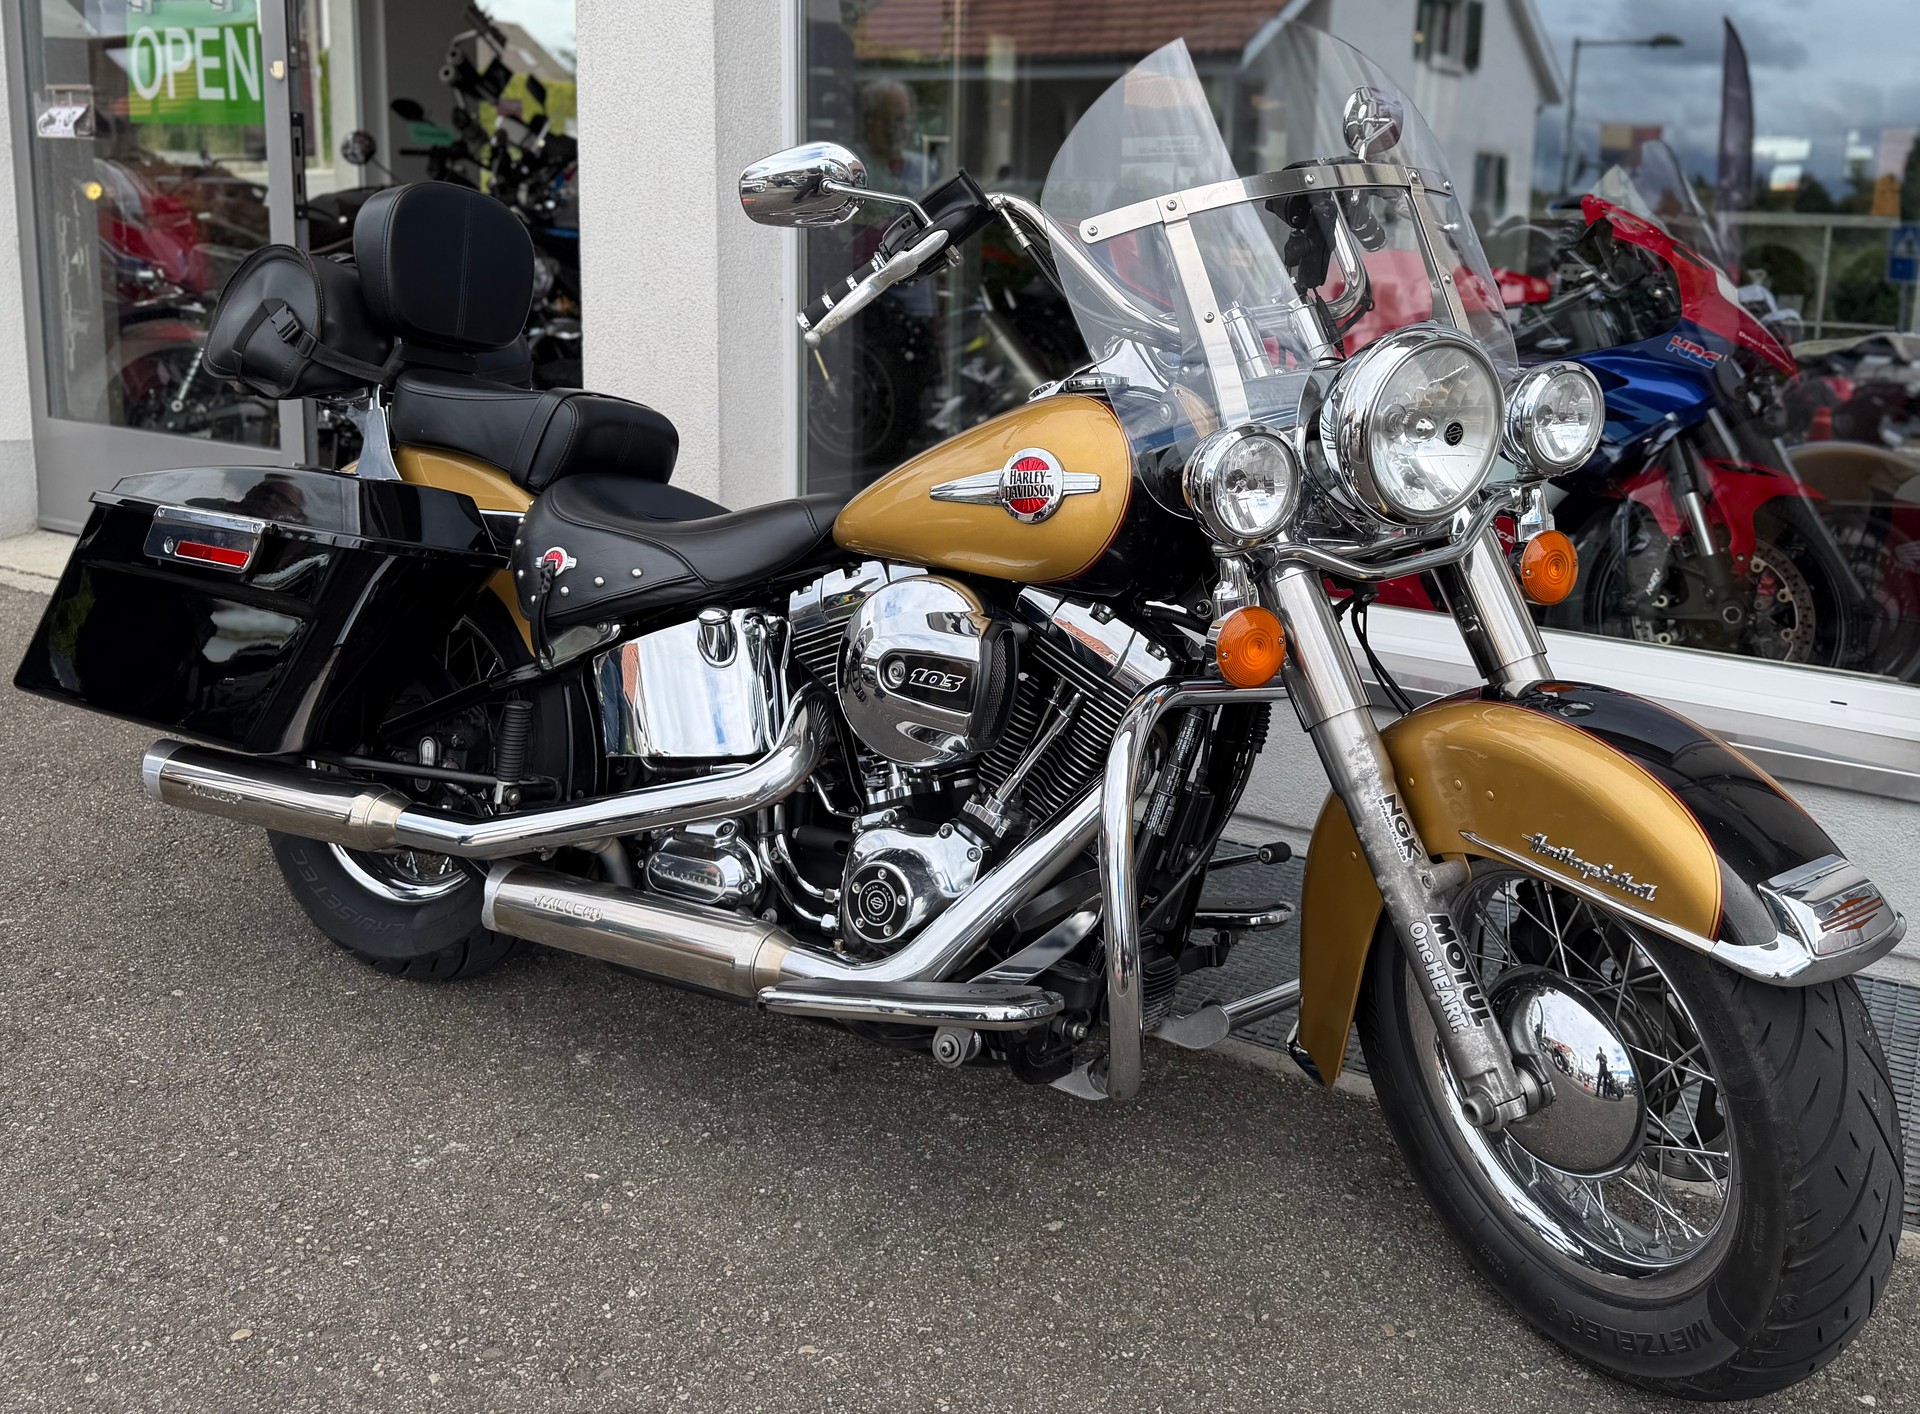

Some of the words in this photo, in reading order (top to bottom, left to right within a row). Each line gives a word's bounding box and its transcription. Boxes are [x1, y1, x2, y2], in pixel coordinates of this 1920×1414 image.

[131, 26, 261, 102] OPEN
[1665, 335, 1722, 369] HRC
[1005, 484, 1055, 502] DAVIDSON
[1009, 470, 1052, 485] HARLEY-
[909, 667, 967, 692] 103
[1378, 798, 1394, 830] SPARK
[1391, 831, 1408, 862] PLUGS
[1382, 792, 1422, 860] NGK
[1409, 920, 1470, 1034] OneHEART.
[1427, 914, 1491, 1028] MOTUL
[1566, 1308, 1713, 1356] METZELER
